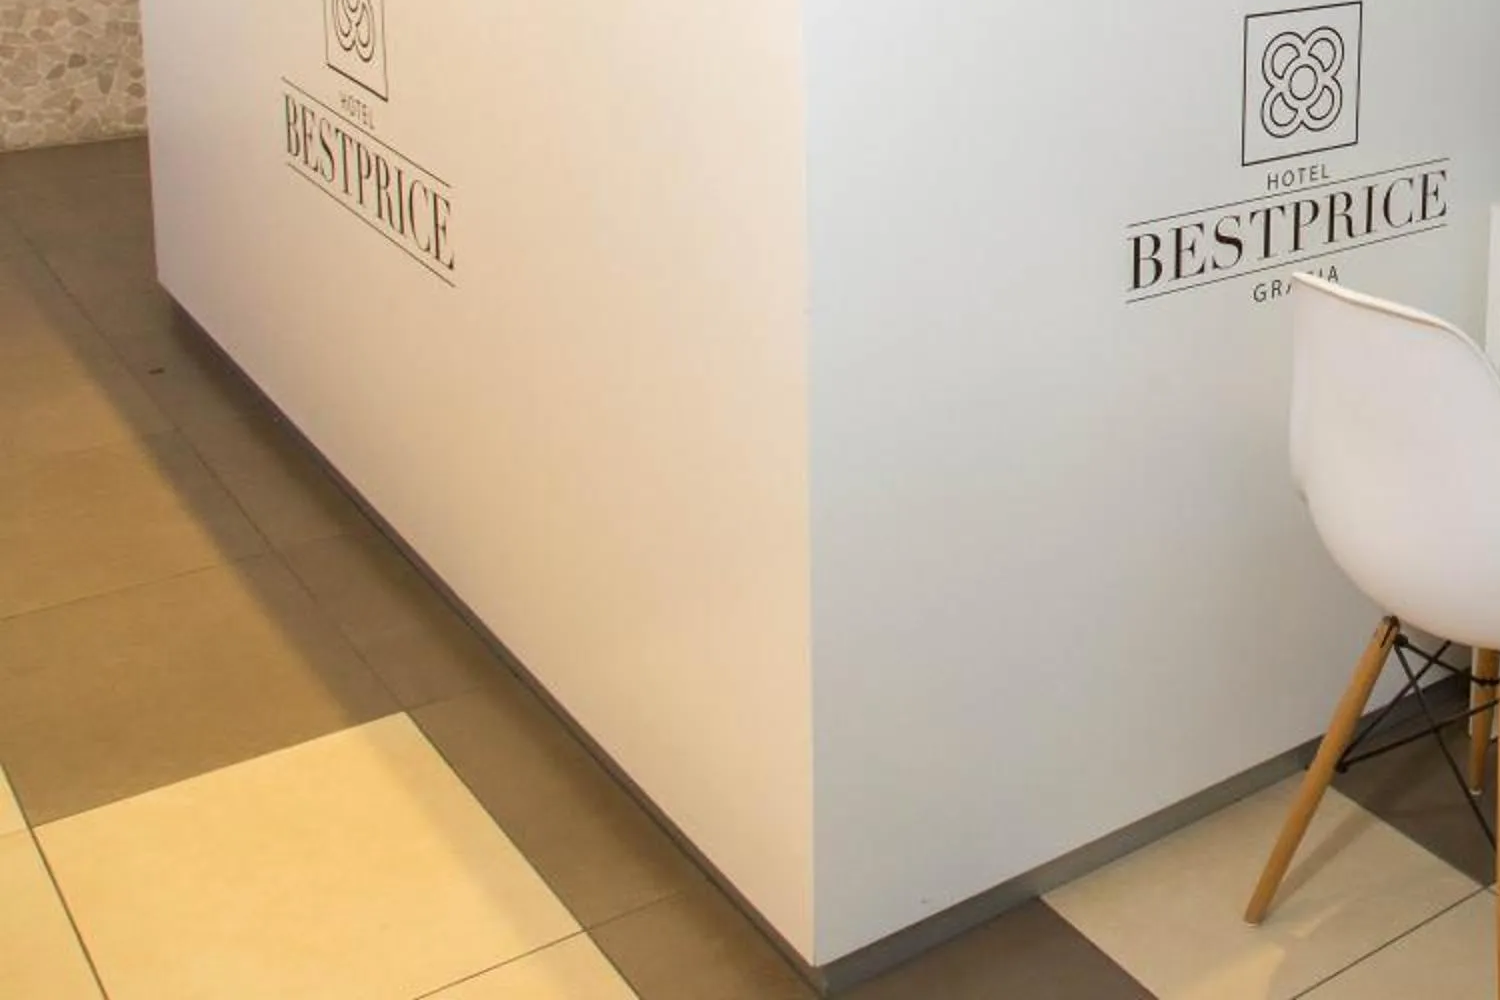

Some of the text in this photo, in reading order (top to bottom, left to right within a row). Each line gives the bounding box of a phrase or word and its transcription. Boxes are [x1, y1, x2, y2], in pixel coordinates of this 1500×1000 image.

[283, 92, 455, 270] BESTPRICE
[1266, 163, 1330, 191] HOTEL
[1126, 169, 1448, 292] BESTPRICE
[1253, 265, 1339, 303] GRIA
